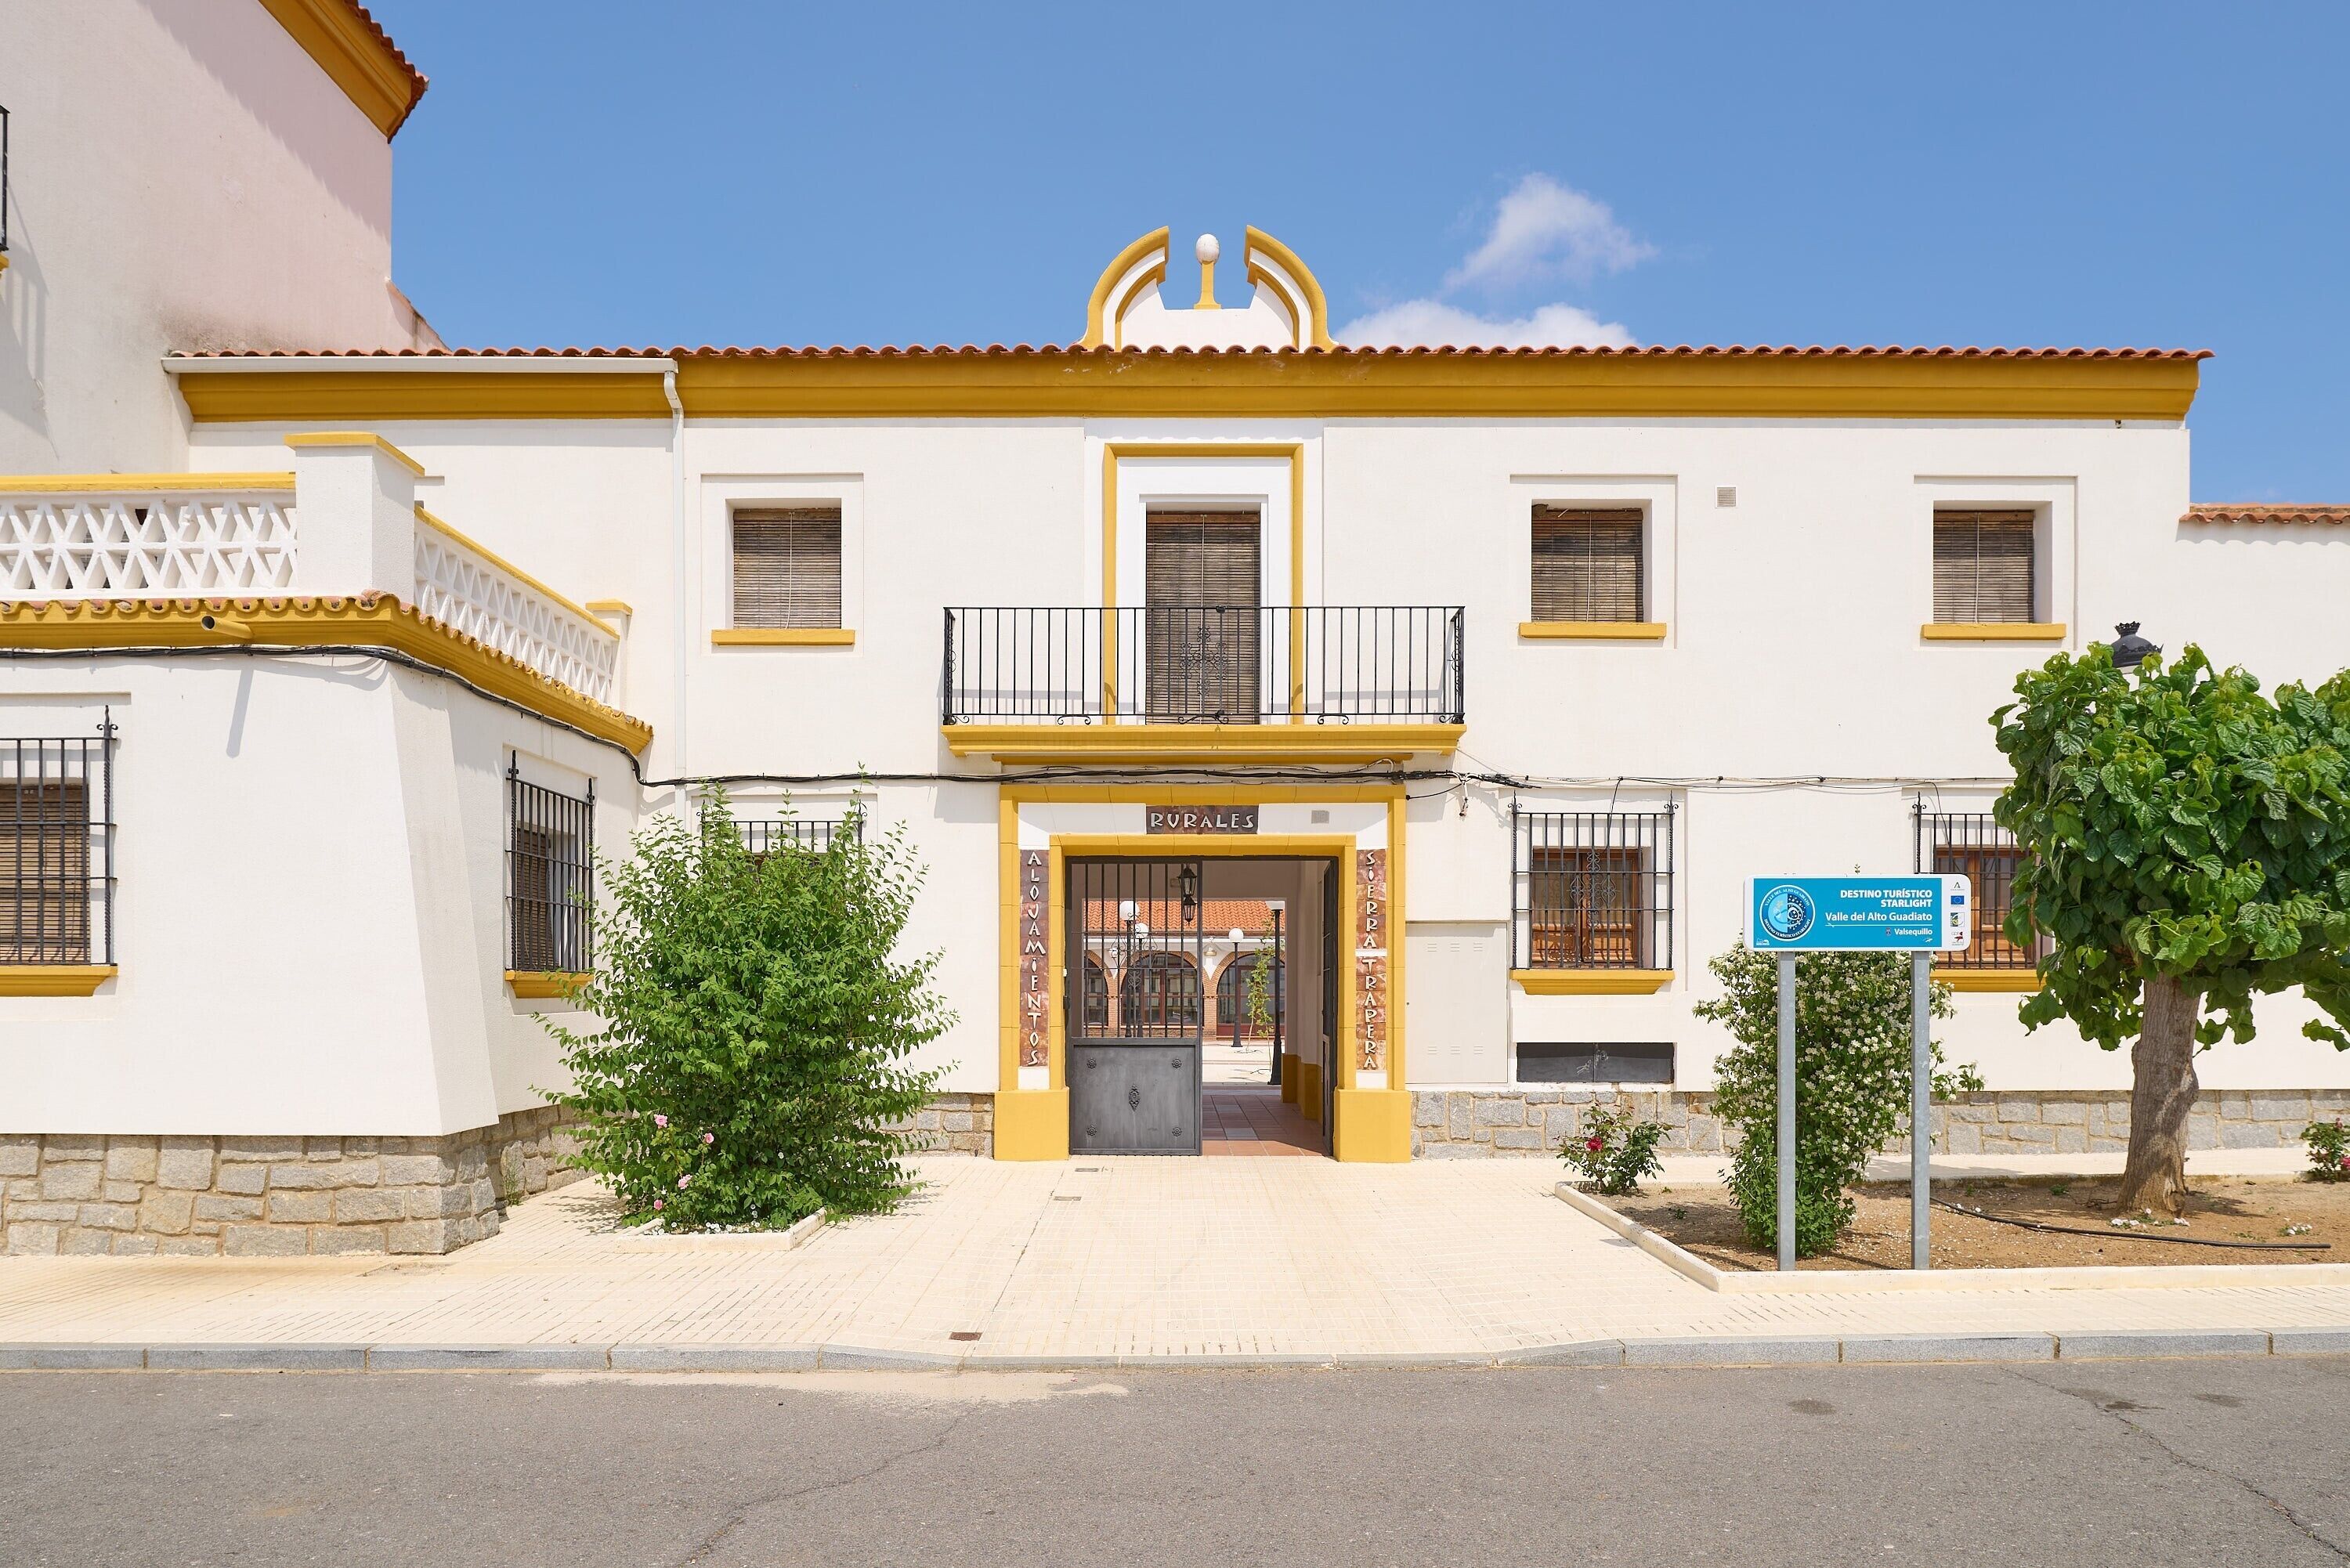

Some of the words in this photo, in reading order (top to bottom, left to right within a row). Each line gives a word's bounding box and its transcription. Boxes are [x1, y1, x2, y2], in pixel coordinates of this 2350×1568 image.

[1840, 889, 1882, 898] DESTINO
[1882, 887, 1932, 898] TURÍSTICO
[1880, 899, 1932, 908] STARLIGHT
[1825, 912, 1849, 921] Valle
[1850, 912, 1865, 921] del
[1867, 912, 1887, 921] Alto
[1889, 912, 1932, 921] Guadiato
[1362, 959, 1377, 1068] TRAPERA
